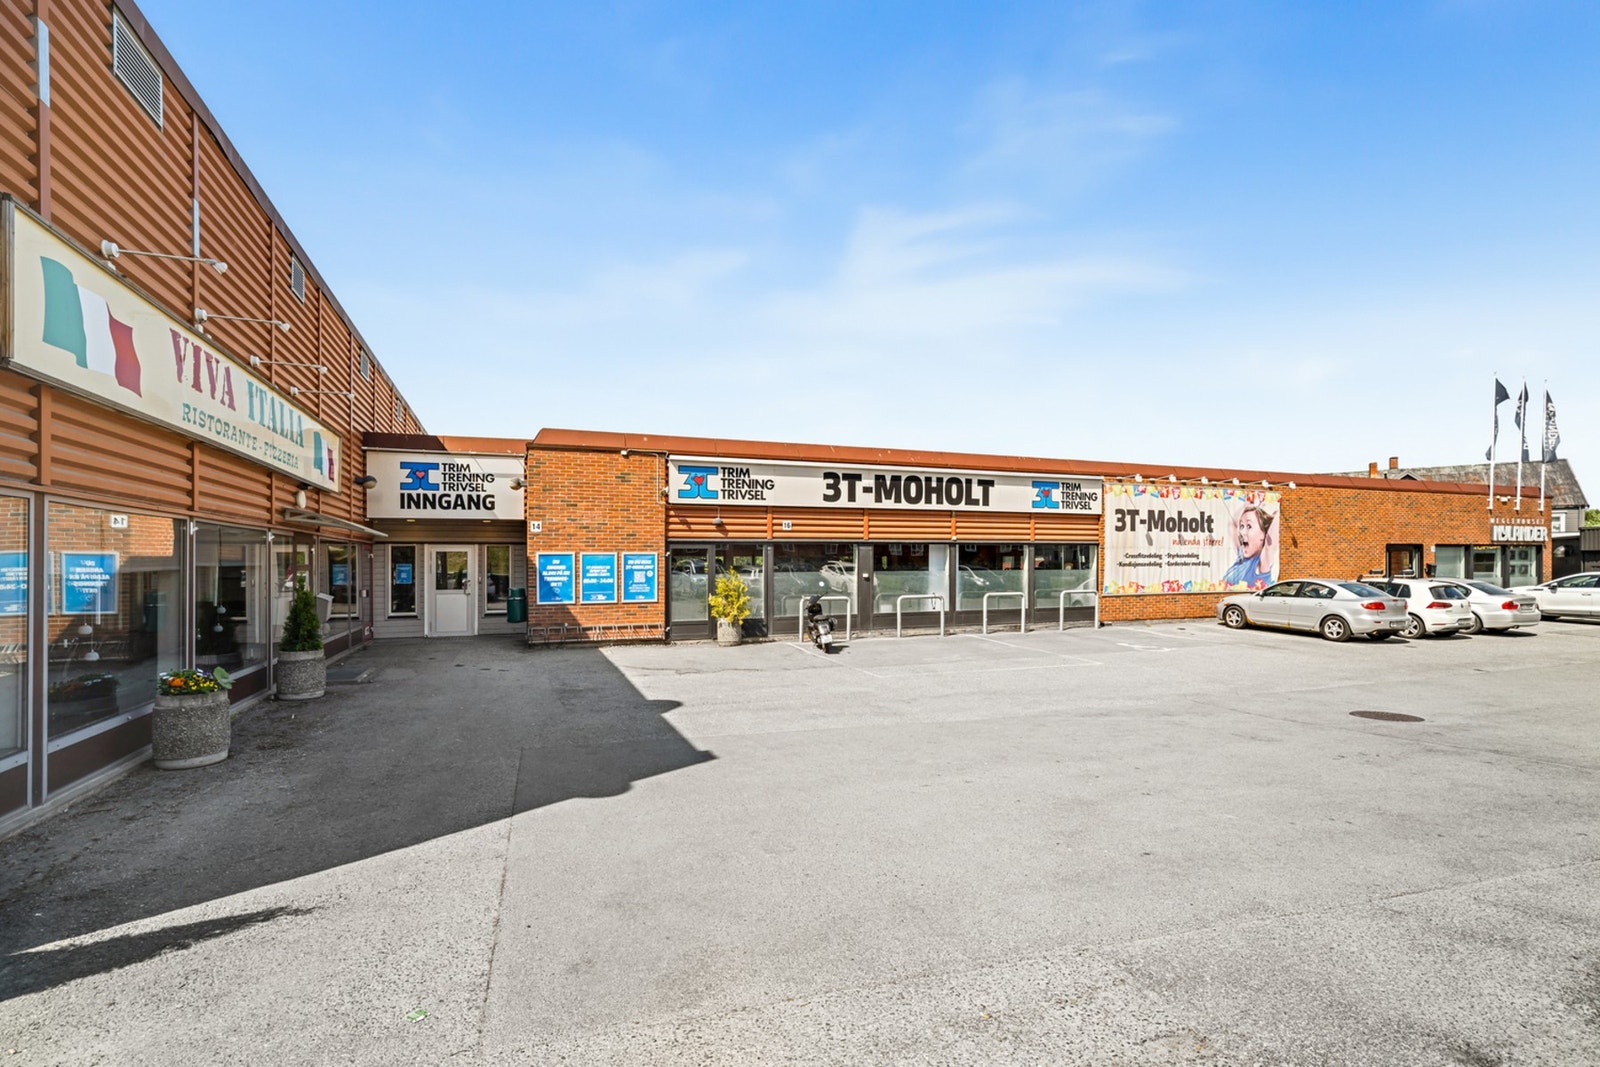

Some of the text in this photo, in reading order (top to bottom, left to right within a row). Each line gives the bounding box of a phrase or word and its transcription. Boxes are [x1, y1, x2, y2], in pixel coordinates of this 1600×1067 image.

[169, 327, 305, 449] VIVA ITALIA
[182, 402, 258, 451] RISTORANTE
[263, 441, 299, 469] PIZZERIA
[441, 462, 471, 473] TRIM
[720, 466, 751, 478] TRIM
[441, 472, 495, 484] TRENING
[720, 478, 775, 490] TRENING
[441, 482, 487, 492] TRIVSEL
[822, 471, 995, 507] 3T-MOHOLT
[1060, 482, 1082, 492] TRIM
[400, 492, 495, 510] INNGANG
[720, 489, 767, 501] TRIVSEL
[1060, 491, 1098, 502] TRENING
[1060, 500, 1092, 510] TRIVSEL
[1114, 508, 1214, 533] 3T-Moholt
